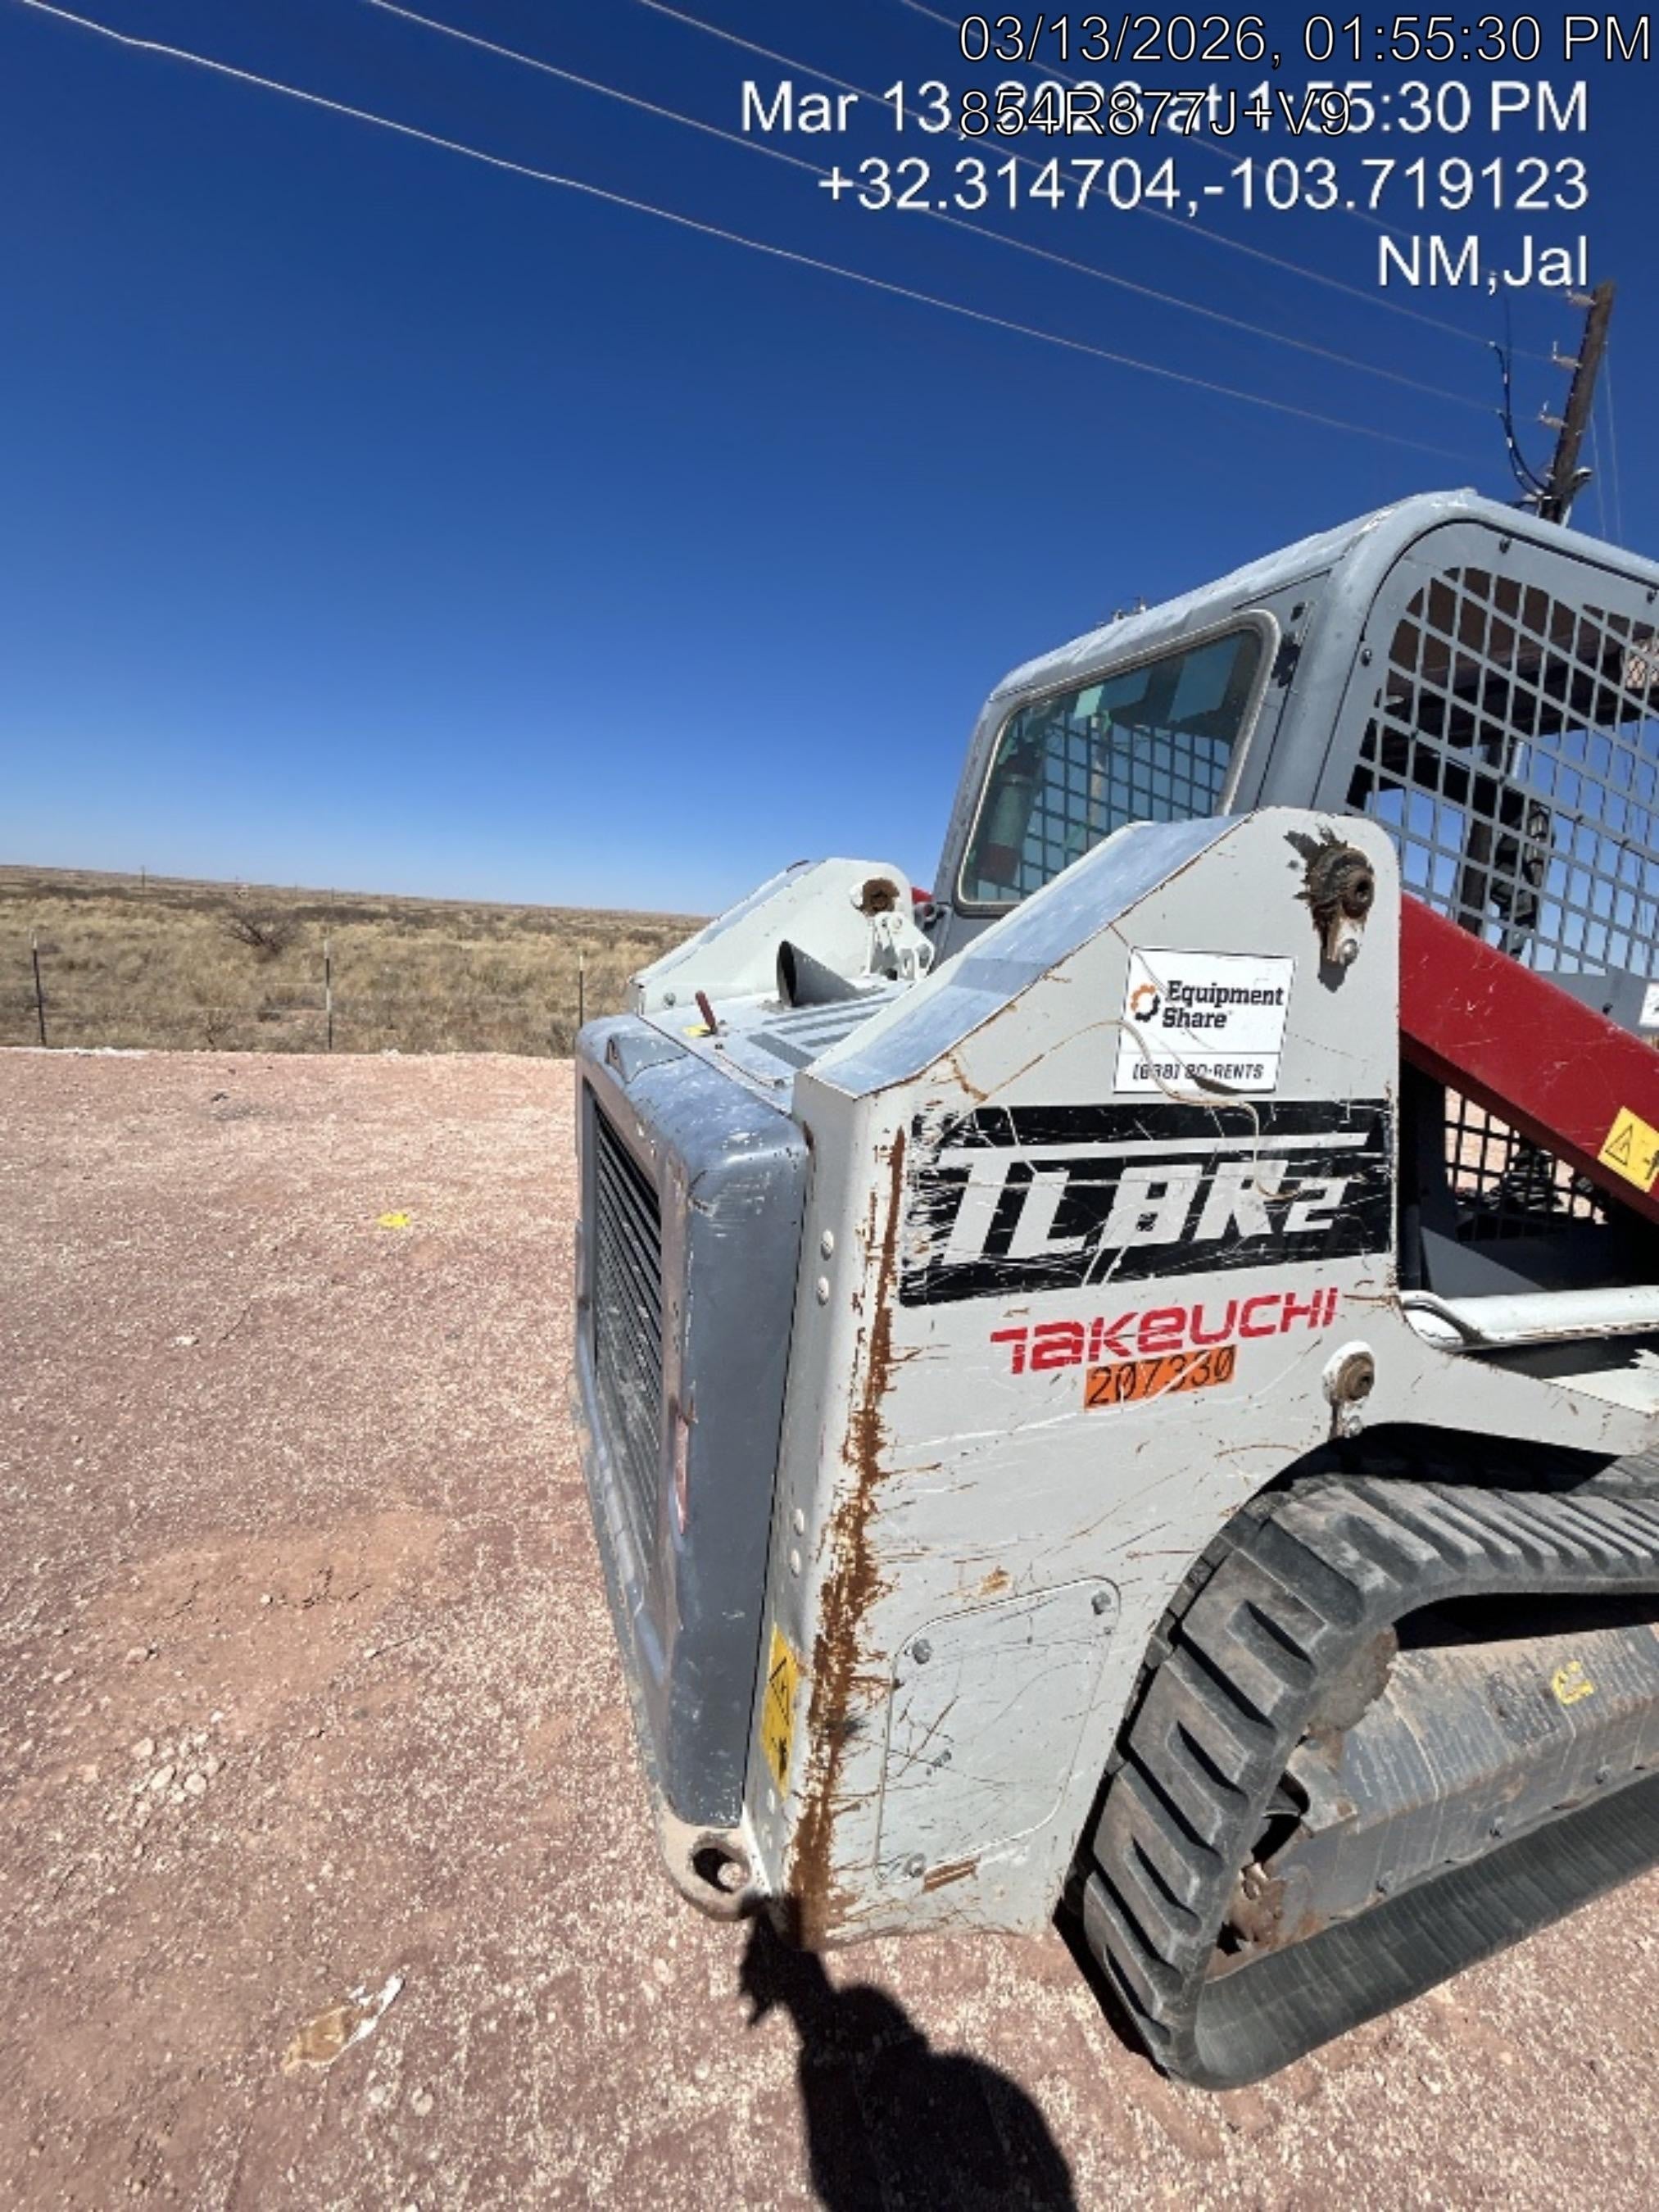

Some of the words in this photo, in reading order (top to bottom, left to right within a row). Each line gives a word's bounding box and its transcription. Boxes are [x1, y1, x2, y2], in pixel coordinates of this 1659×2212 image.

[1167, 981, 1285, 1009] Equipment
[1162, 1007, 1228, 1029] Share
[1087, 1344, 1236, 1407] 207330
